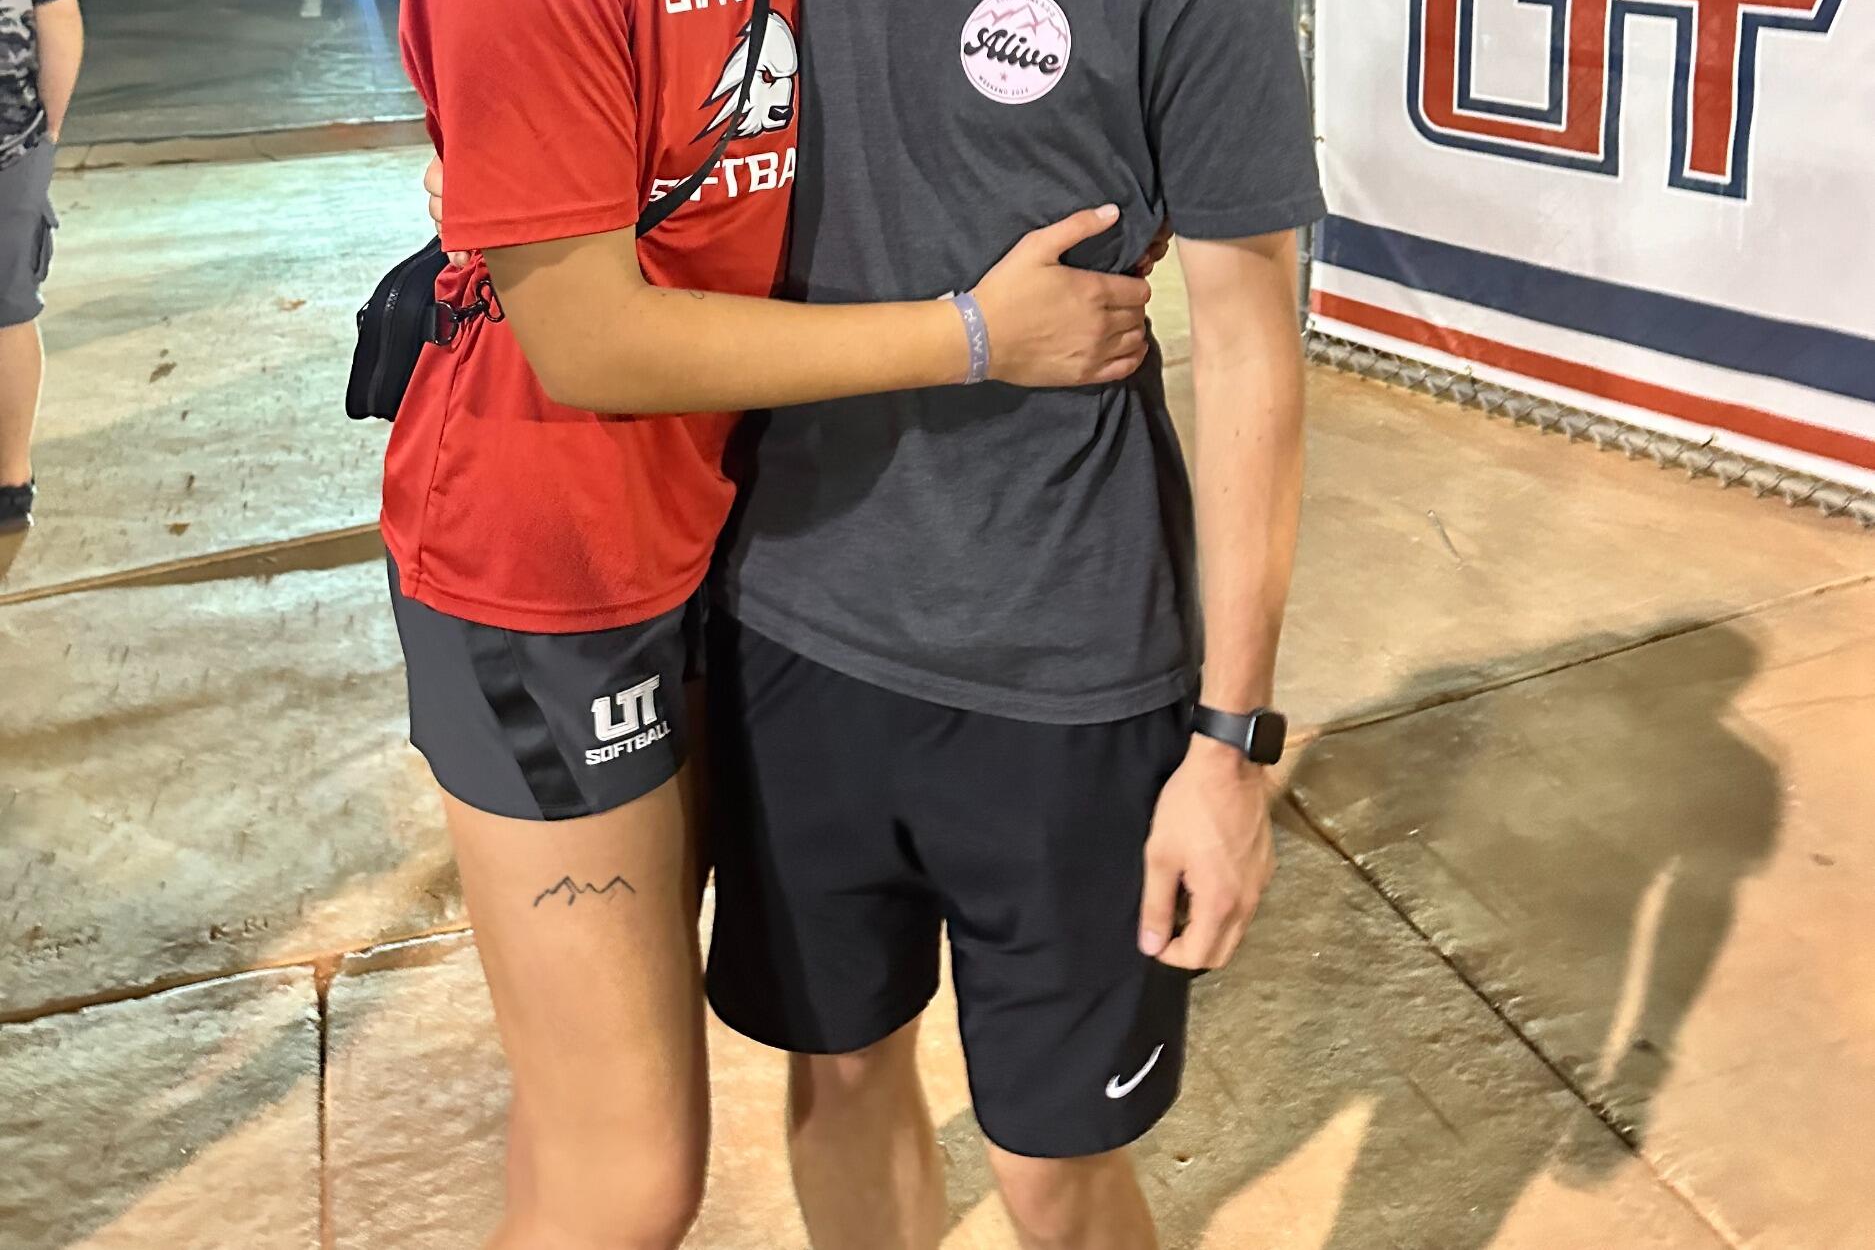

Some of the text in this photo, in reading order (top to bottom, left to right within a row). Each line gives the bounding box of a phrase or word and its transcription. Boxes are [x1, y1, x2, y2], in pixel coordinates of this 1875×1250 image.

[963, 27, 1061, 75] Alive
[591, 674, 660, 741] UT
[585, 720, 672, 766] SOFTBALL
